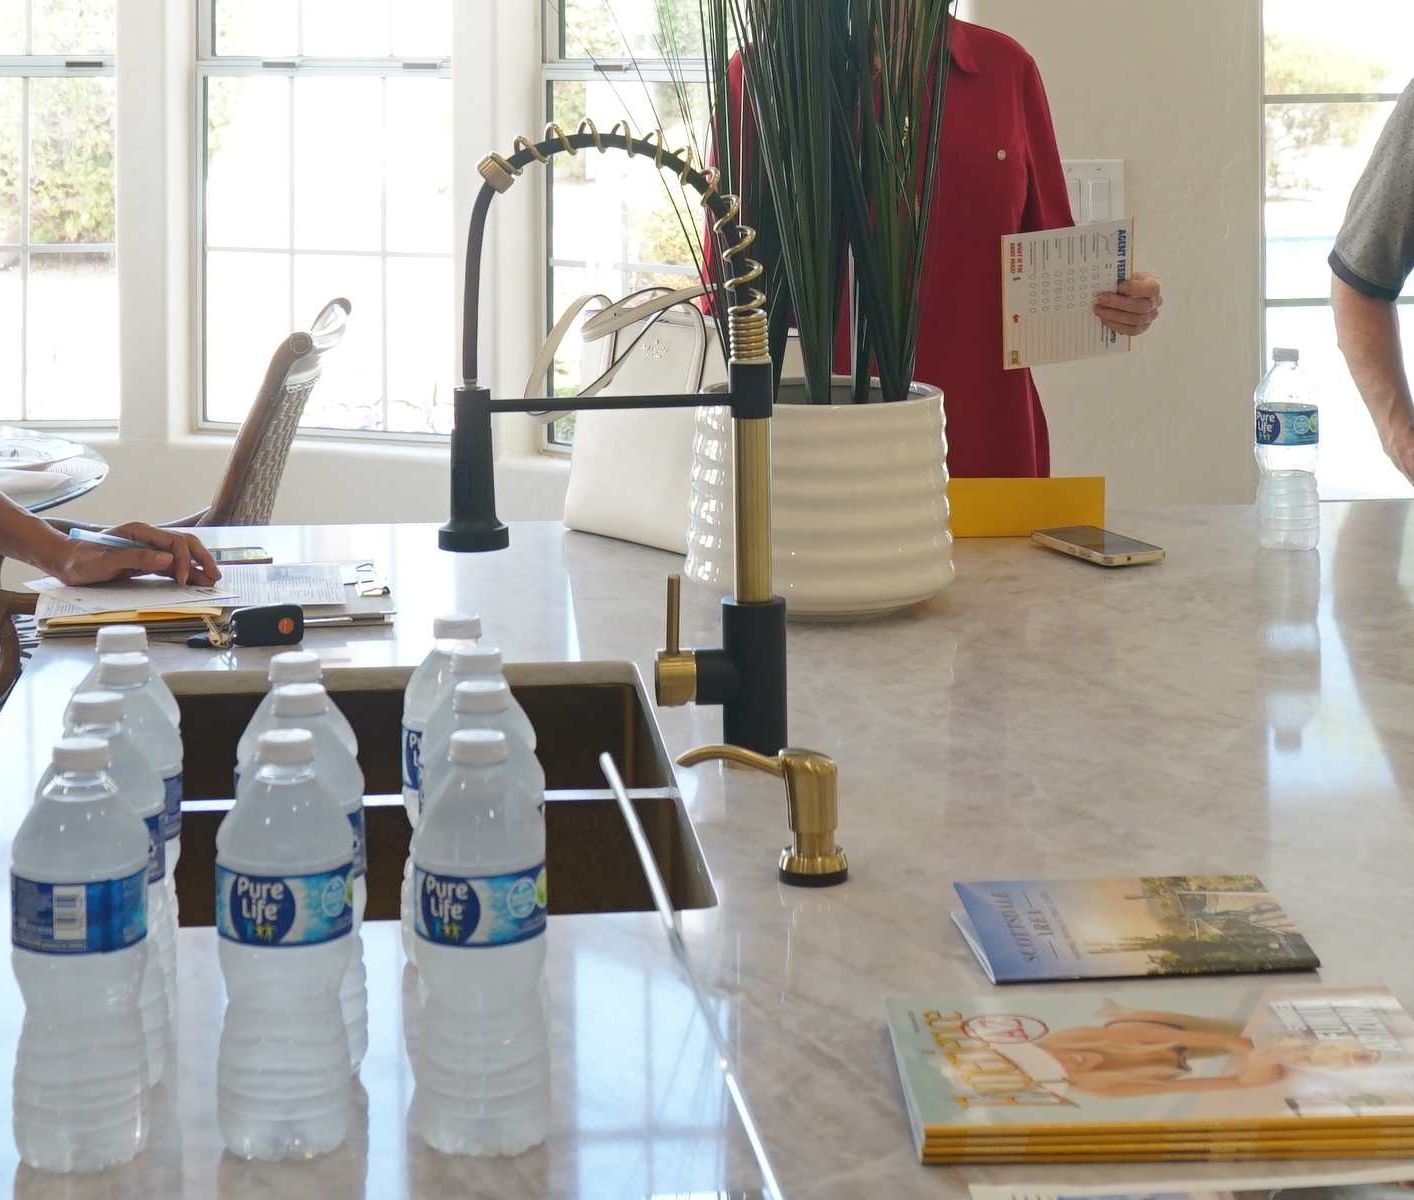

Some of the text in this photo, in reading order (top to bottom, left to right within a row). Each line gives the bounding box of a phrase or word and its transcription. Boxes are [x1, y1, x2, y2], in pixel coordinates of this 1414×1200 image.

[1116, 229, 1126, 292] AGENT FEEDB
[1257, 411, 1275, 422] Pure
[1258, 420, 1273, 434] Life
[237, 874, 284, 900] Pure
[426, 874, 468, 900] Pure
[241, 896, 278, 925] Life
[430, 896, 463, 924] Life
[1025, 910, 1054, 936] AREA
[990, 892, 1041, 962] SCOTTSDALE
[1301, 1015, 1355, 1040] FUN
[1327, 998, 1405, 1052] ARIZONA
